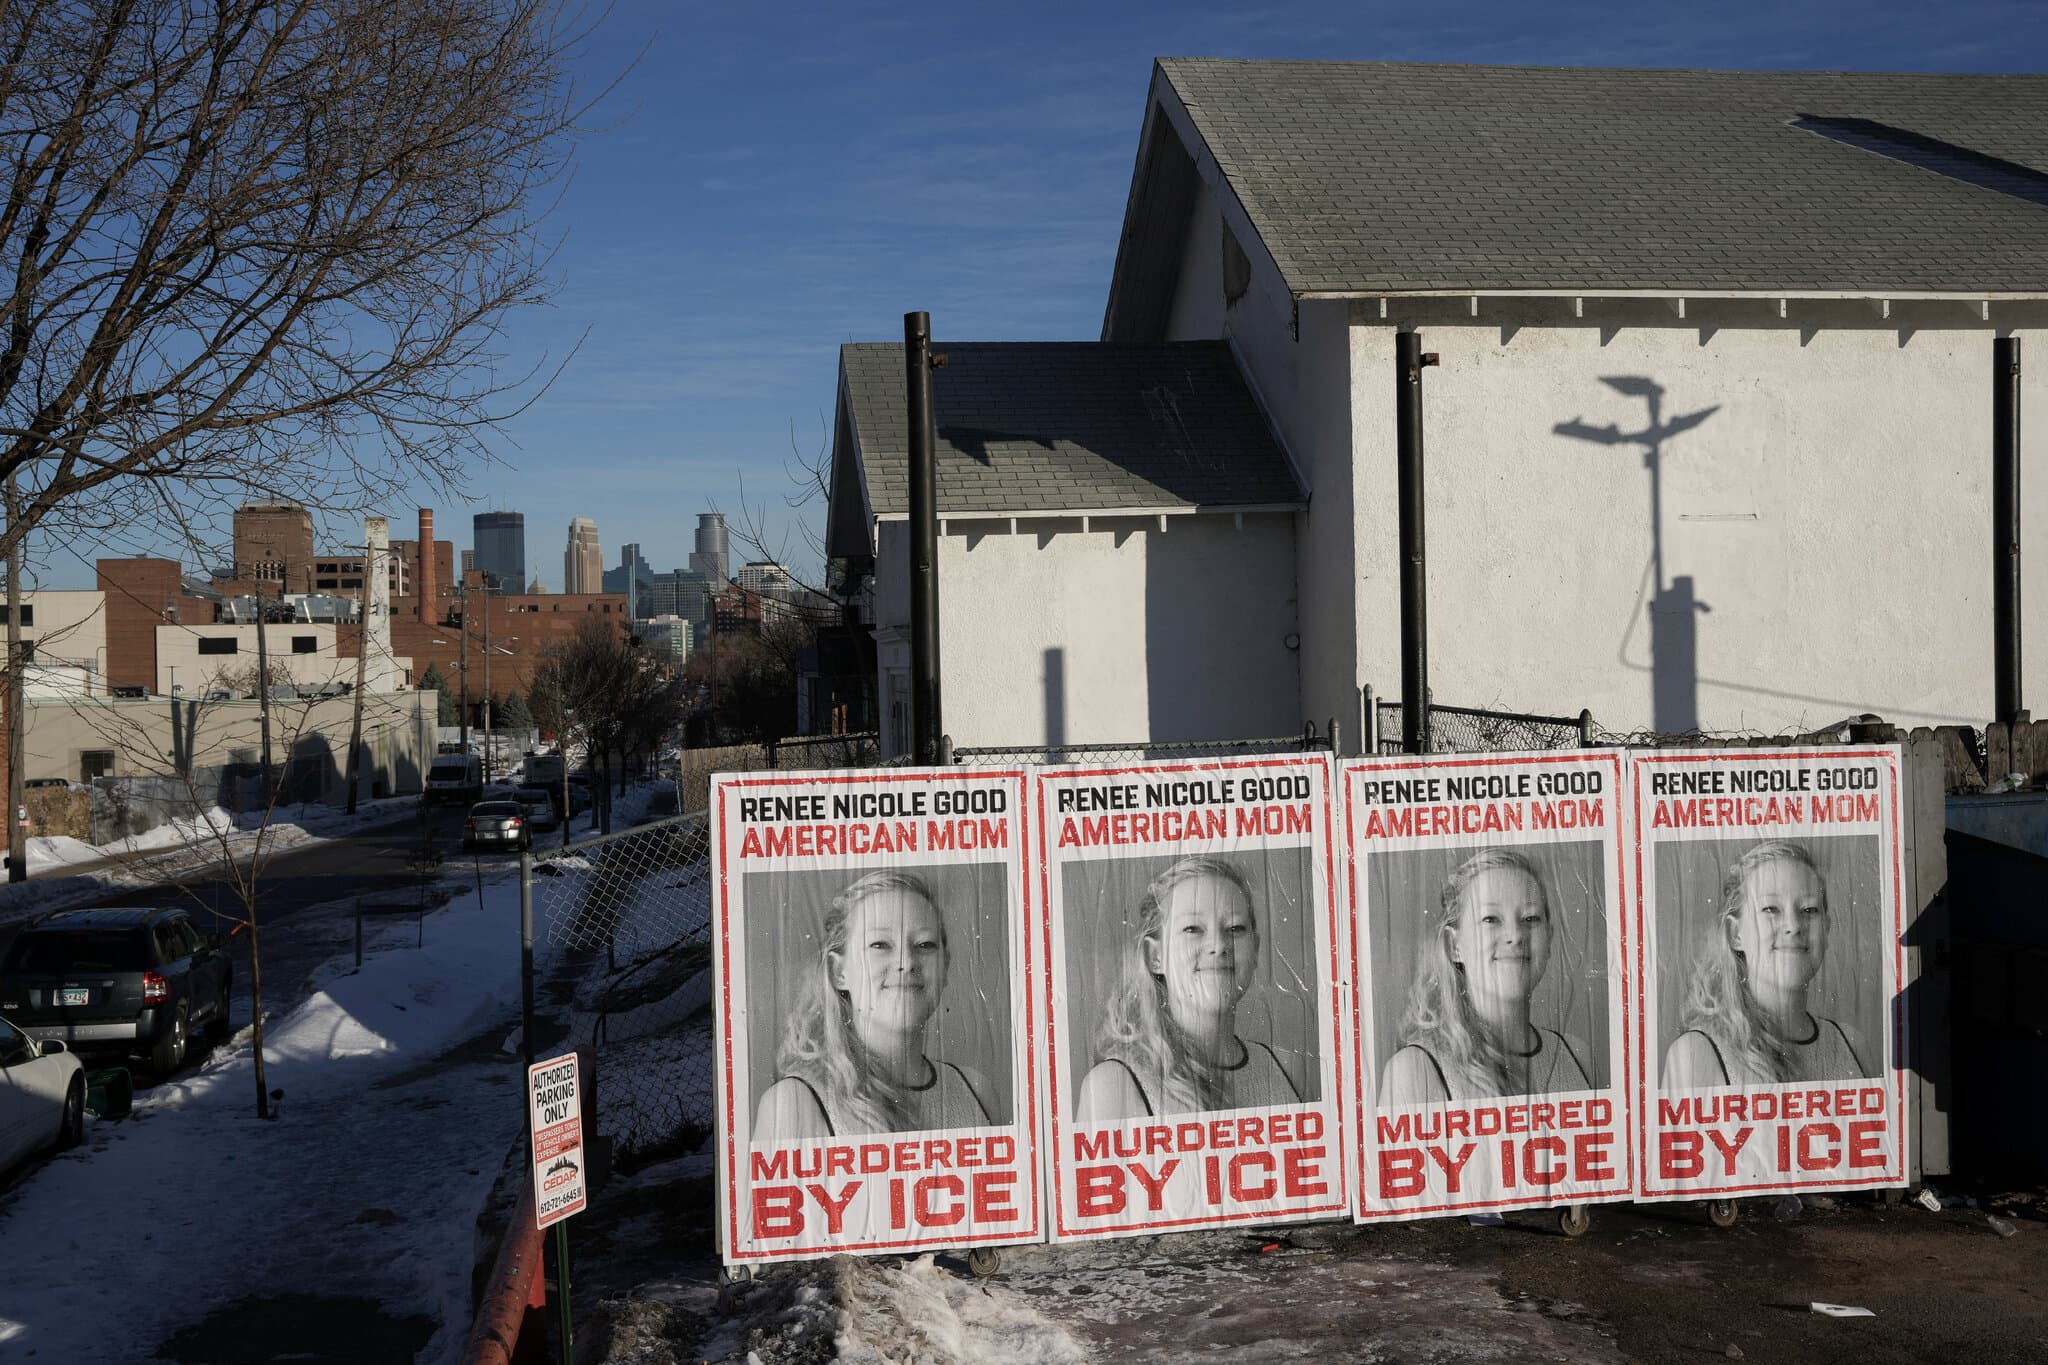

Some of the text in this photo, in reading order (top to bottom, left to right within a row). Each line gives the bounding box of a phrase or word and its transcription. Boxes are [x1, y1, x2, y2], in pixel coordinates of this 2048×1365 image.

[1059, 776, 1309, 812] RENEE NICOLE GOOD
[1365, 772, 1601, 804] RENEE NICOLE GOOD
[1653, 767, 1877, 795] RENEE NICOLE GOOD
[741, 790, 1006, 822] RENEE NICOLE GOOD
[1365, 799, 1604, 839] AMERICAN MOM
[1652, 794, 1879, 828] AMERICAN MOM
[740, 818, 1008, 858] AMERICAN MOM
[1058, 804, 1312, 848] AMERICAN MOM
[534, 1063, 574, 1091] AUTHORIZED
[536, 1082, 574, 1108] PARKING
[544, 1102, 568, 1124] ONLY
[1377, 1099, 1612, 1144] MURDERED
[1658, 1088, 1884, 1126] MURDERED
[1073, 1112, 1323, 1161] MURDERED
[1660, 1120, 1887, 1179] BY ICE
[752, 1136, 1015, 1180] MURDERED
[1378, 1132, 1615, 1199] BY ICE
[544, 1168, 576, 1192] CEDAR
[1076, 1146, 1328, 1218] BY ICE
[540, 1189, 577, 1214] 612-721-6645
[752, 1171, 1018, 1240] BY ICE
